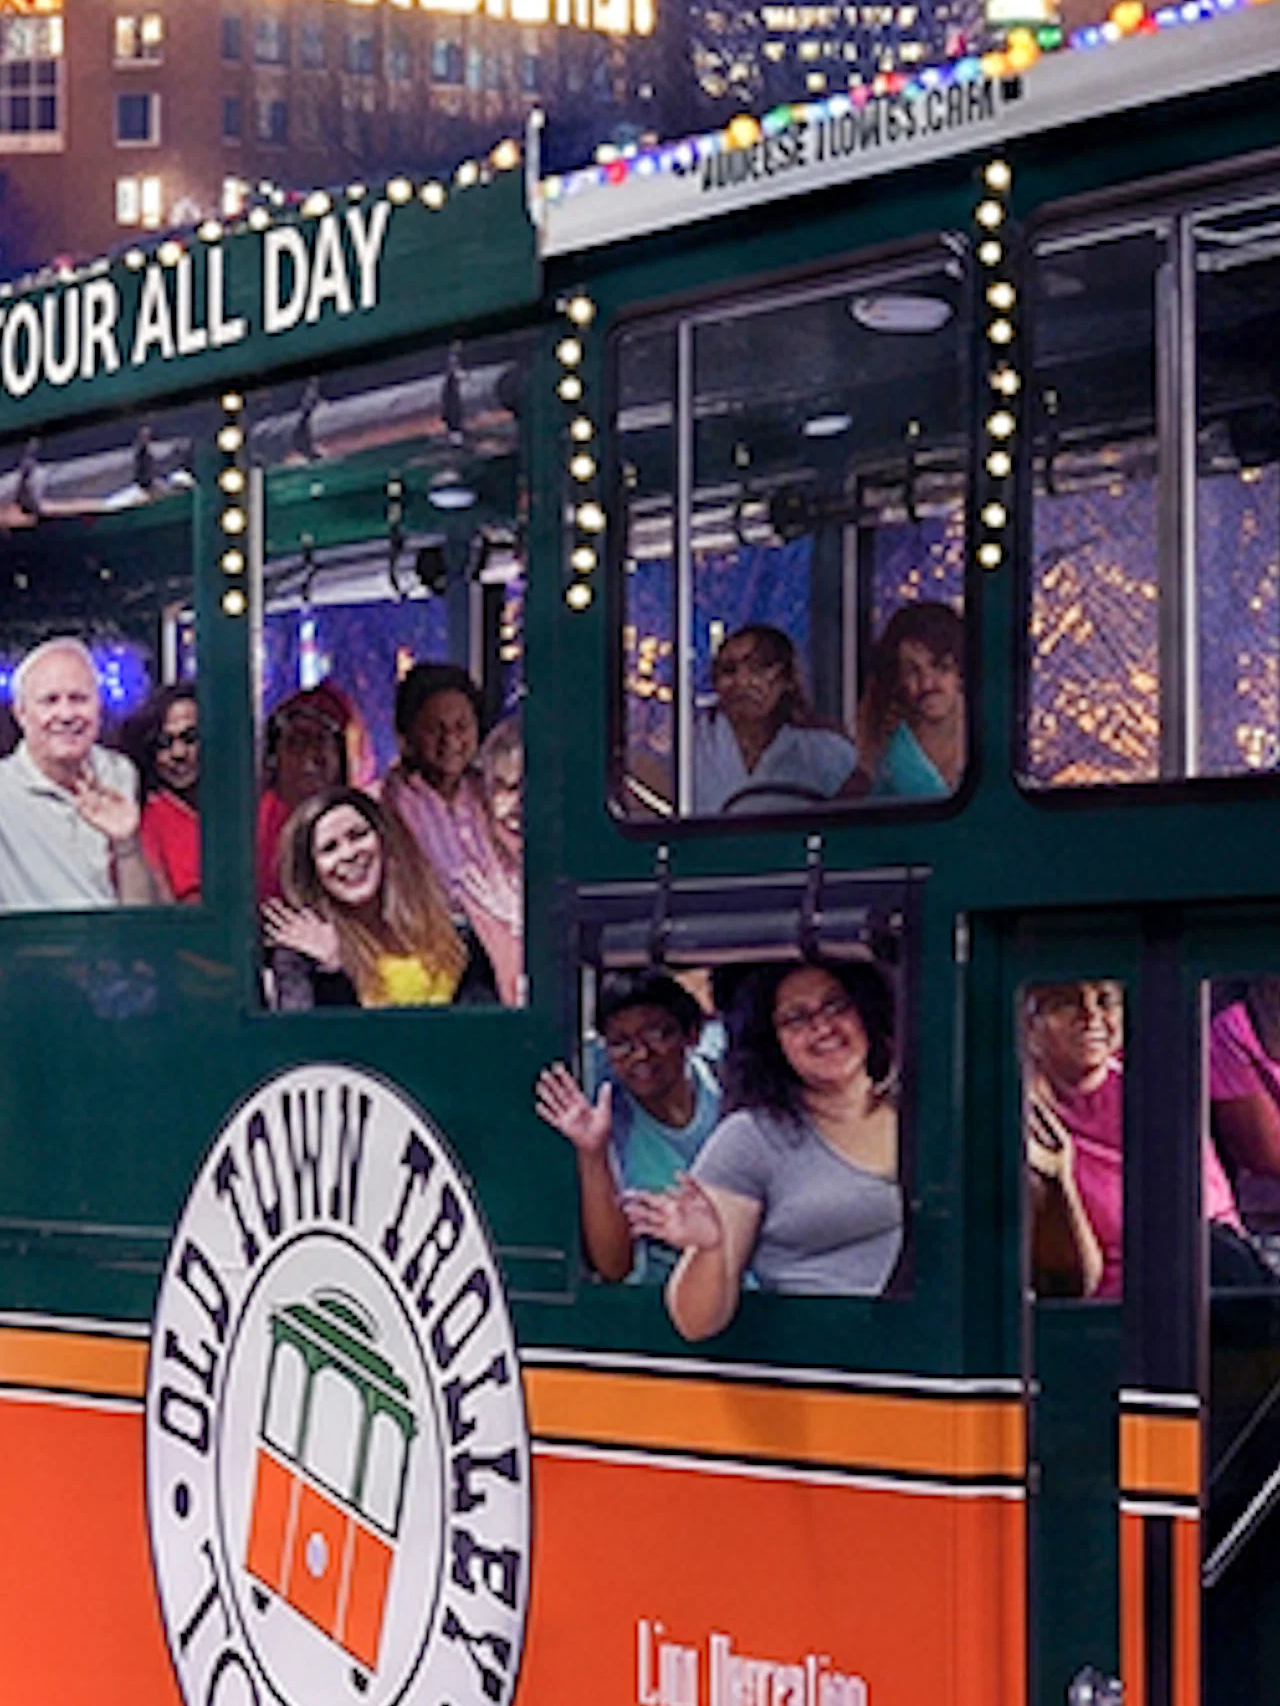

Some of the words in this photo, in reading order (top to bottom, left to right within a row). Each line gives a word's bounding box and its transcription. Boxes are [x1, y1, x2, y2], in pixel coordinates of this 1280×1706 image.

[130, 245, 247, 367] ALL
[262, 200, 390, 335] DAY
[160, 1240, 231, 1455] OLD
[214, 1084, 374, 1266] TOWN
[383, 1129, 520, 1704] TROLLEY
